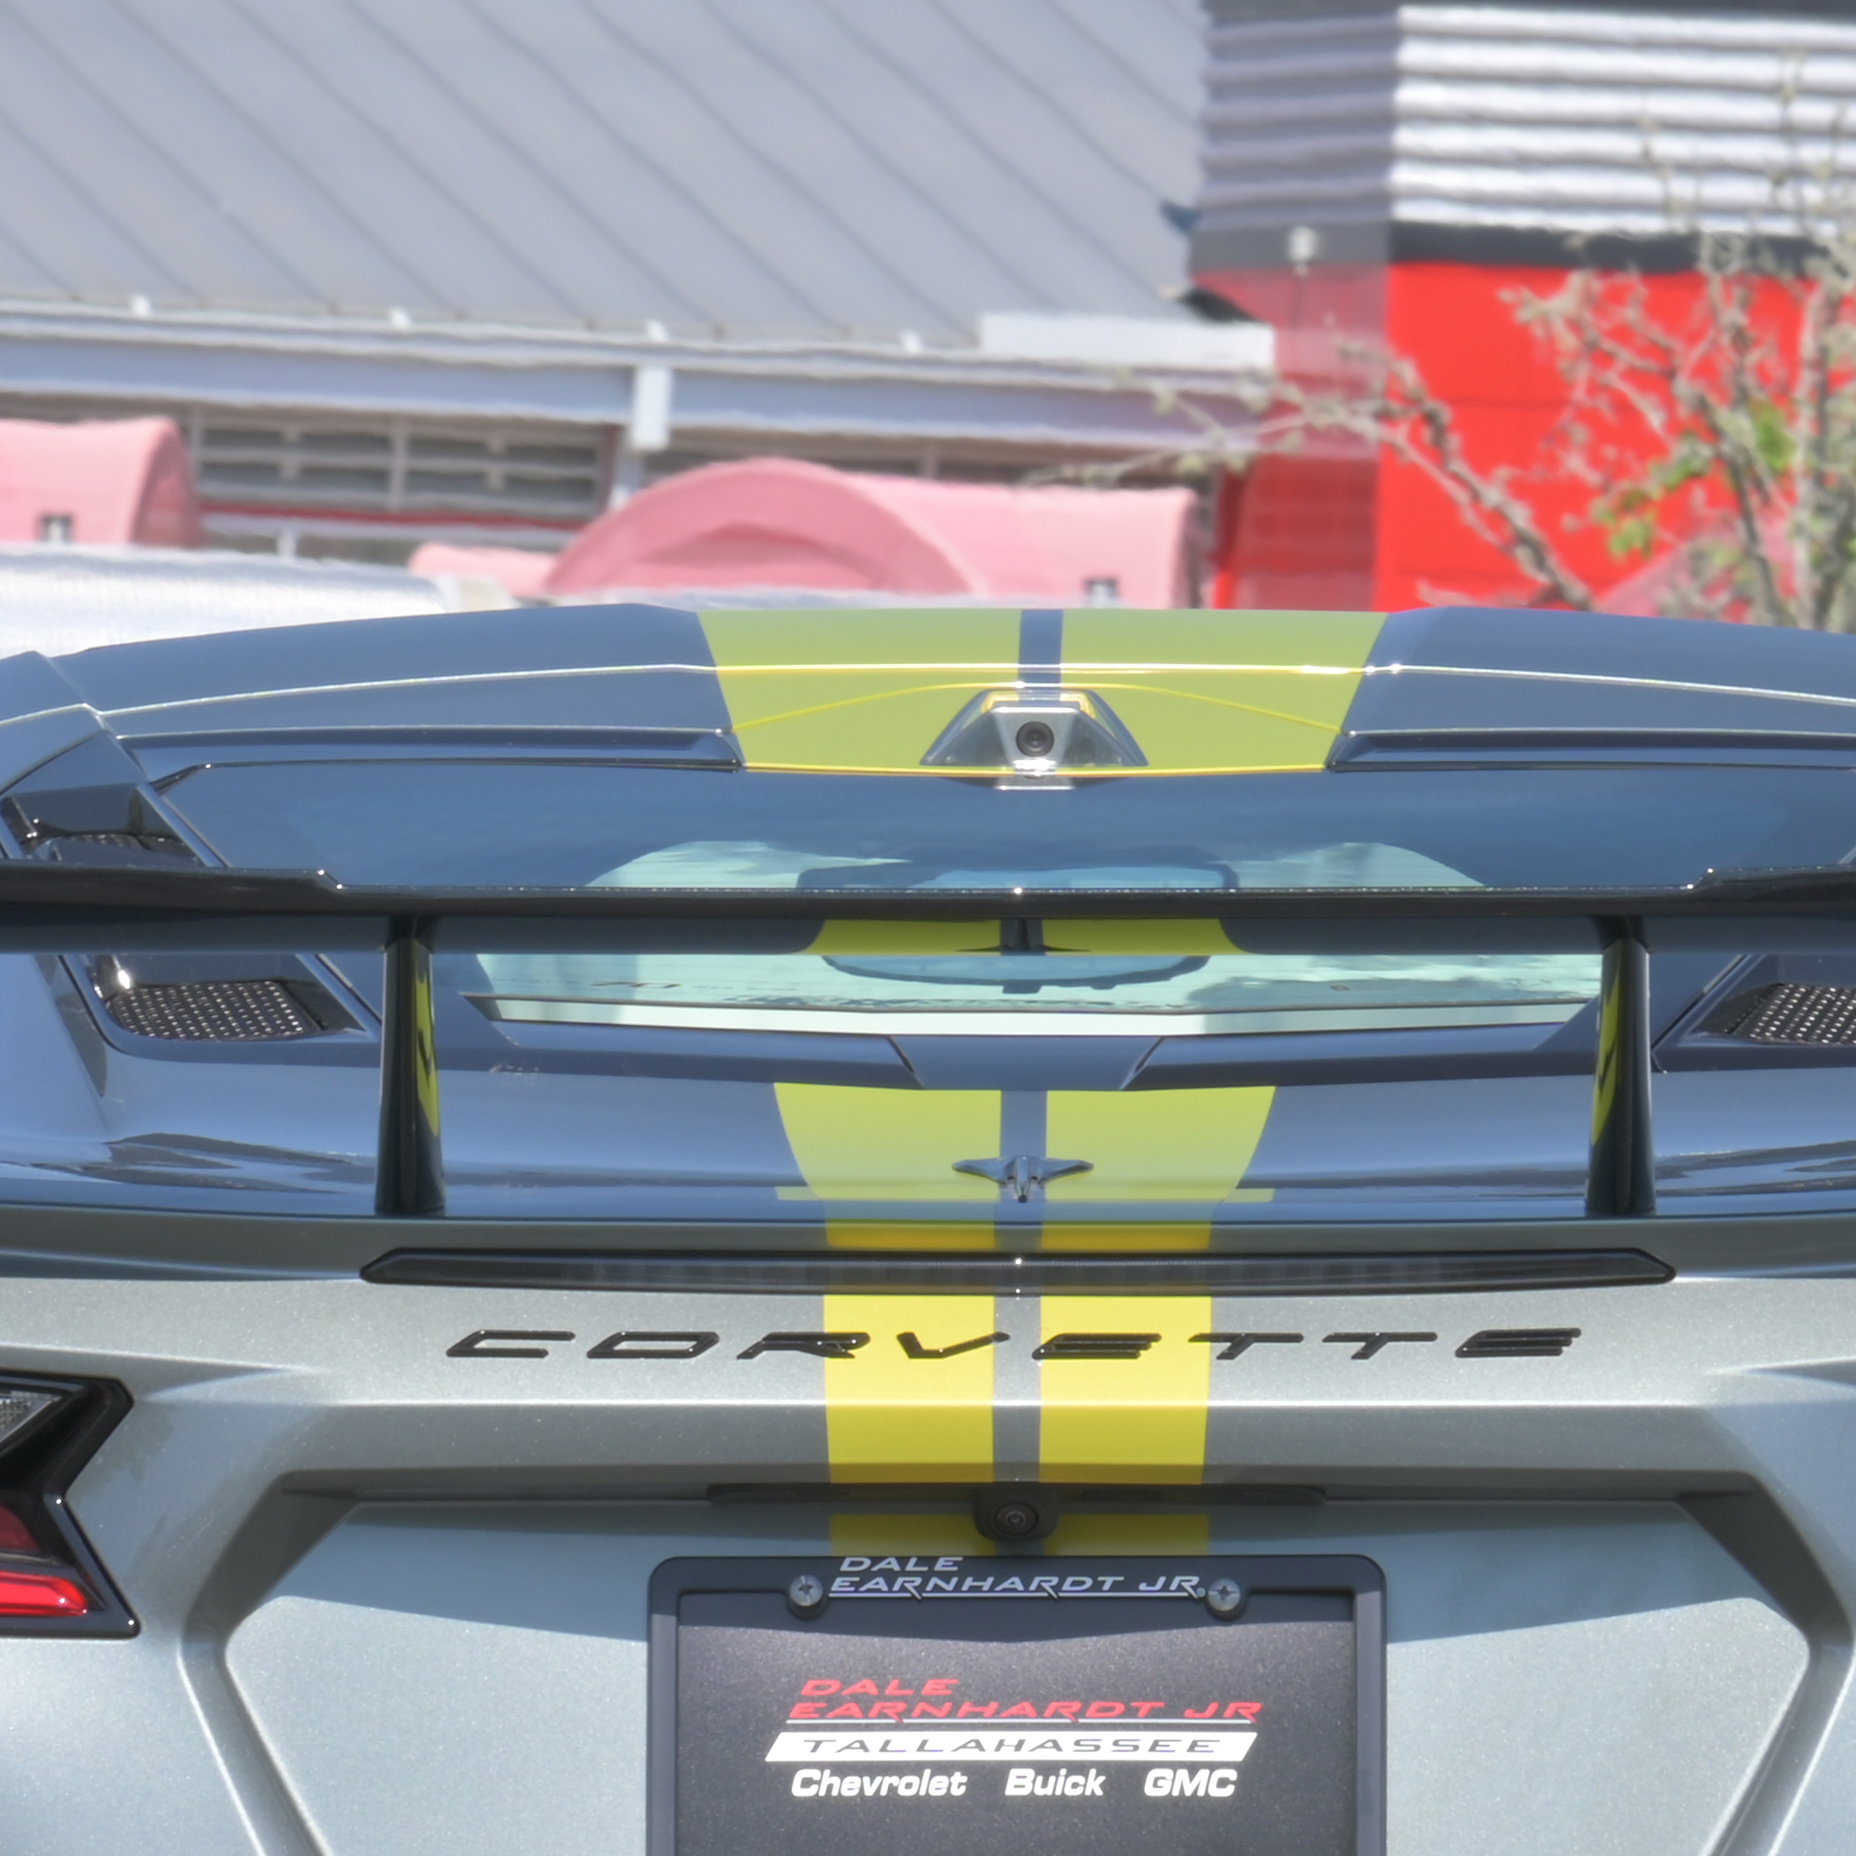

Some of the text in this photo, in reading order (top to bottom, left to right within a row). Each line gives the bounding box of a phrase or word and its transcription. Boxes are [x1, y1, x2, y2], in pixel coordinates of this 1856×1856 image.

[445, 1327, 1583, 1361] CORVETTE
[839, 1556, 964, 1573] DALE
[829, 1575, 1125, 1600] EARNHARDT
[800, 1678, 961, 1697] DALE
[788, 1700, 1264, 1725] EARNHARDT JR
[803, 1738, 1221, 1754] TALLAHASSEE
[791, 1767, 1239, 1798] Chevrolet Buick GMC
